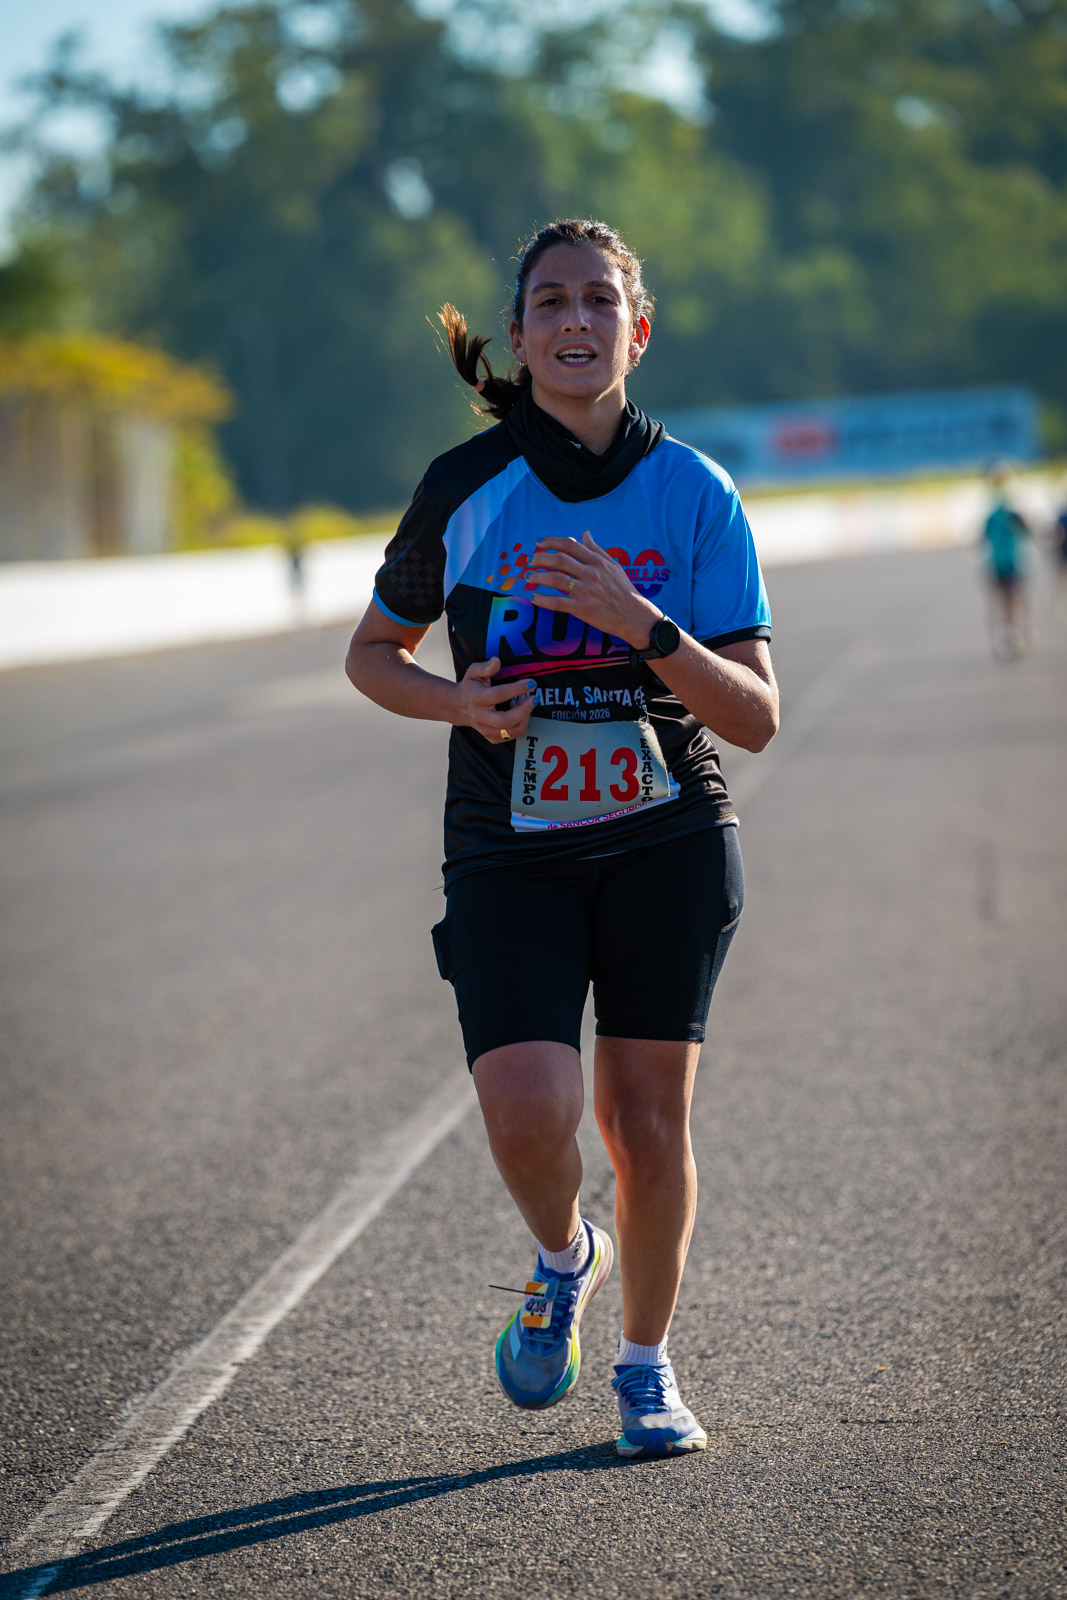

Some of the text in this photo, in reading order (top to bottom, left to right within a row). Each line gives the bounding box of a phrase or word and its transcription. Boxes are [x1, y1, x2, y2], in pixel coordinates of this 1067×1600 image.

[551, 708, 611, 720] EDICIÓN 2026
[583, 686, 633, 707] SANTA
[522, 736, 538, 806] TIEMPO
[540, 745, 640, 803] 213
